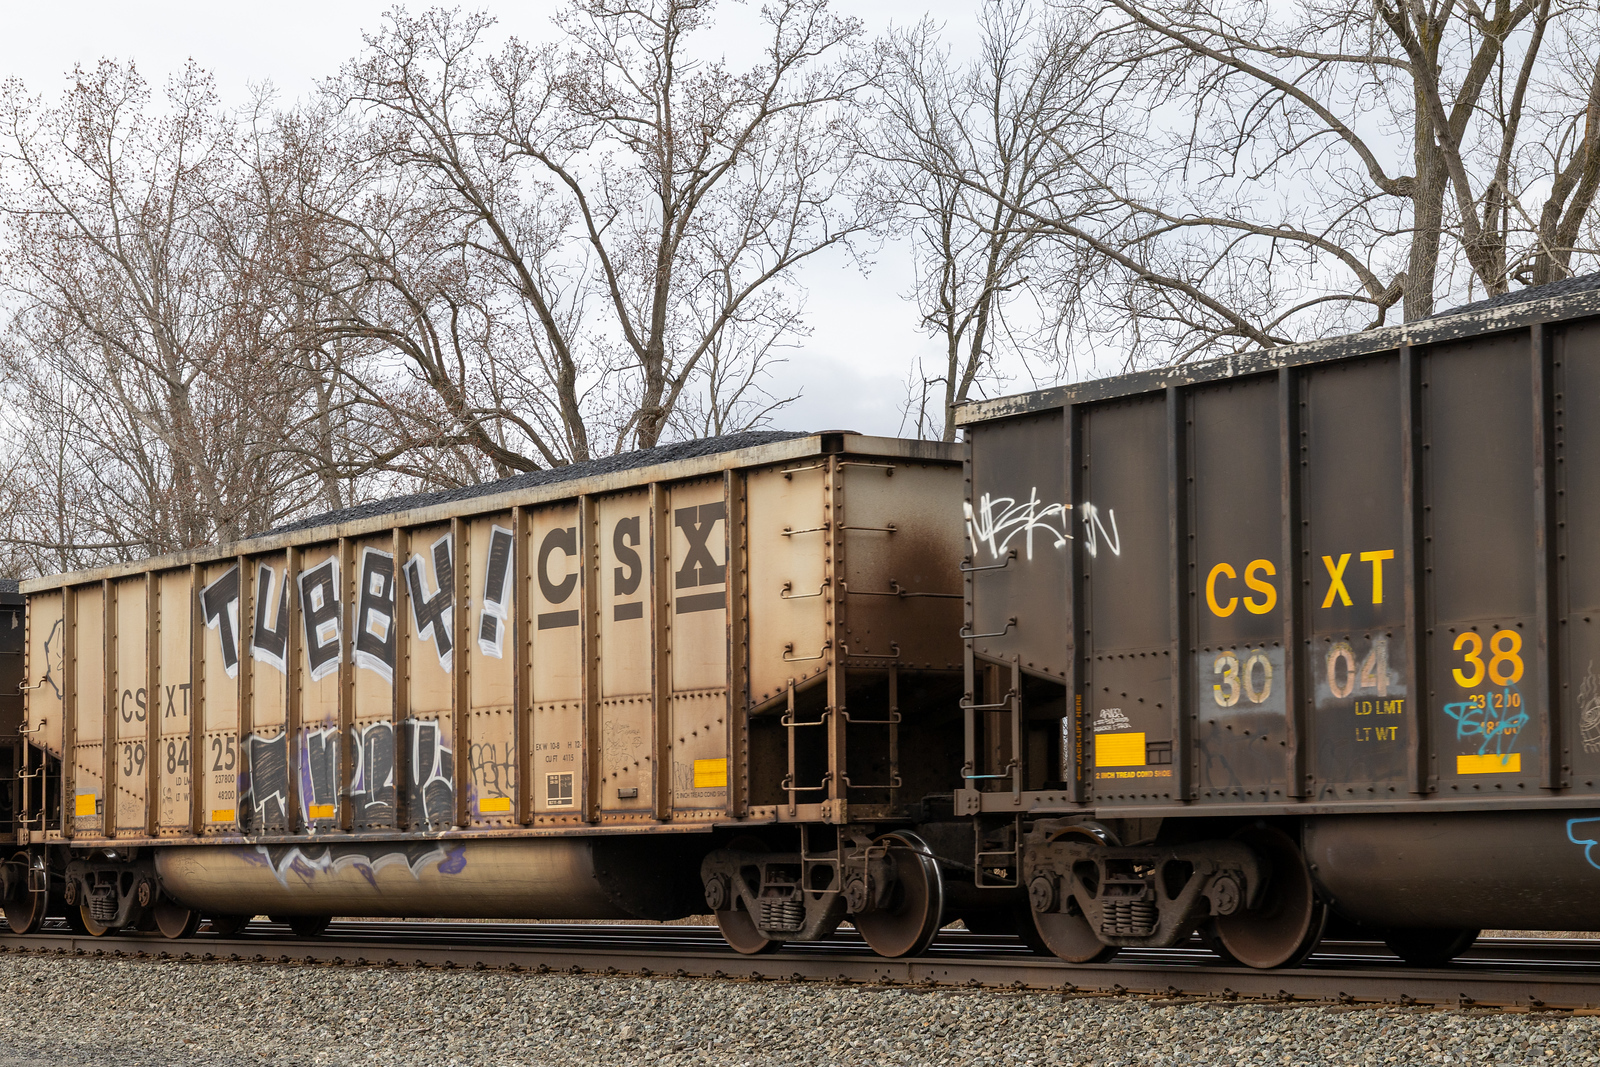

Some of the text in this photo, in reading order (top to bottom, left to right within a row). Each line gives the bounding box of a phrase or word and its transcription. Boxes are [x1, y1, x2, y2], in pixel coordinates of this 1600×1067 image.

[1206, 549, 1394, 617] CS XT
[1213, 650, 1272, 707] 30
[1452, 629, 1524, 688] 38
[121, 683, 190, 723] CS XT
[1355, 700, 1404, 716] LD LMT
[1356, 727, 1398, 742] LT WT
[123, 737, 235, 777] 39 84 25
[214, 774, 235, 784] 237800
[217, 790, 235, 800] 48200
